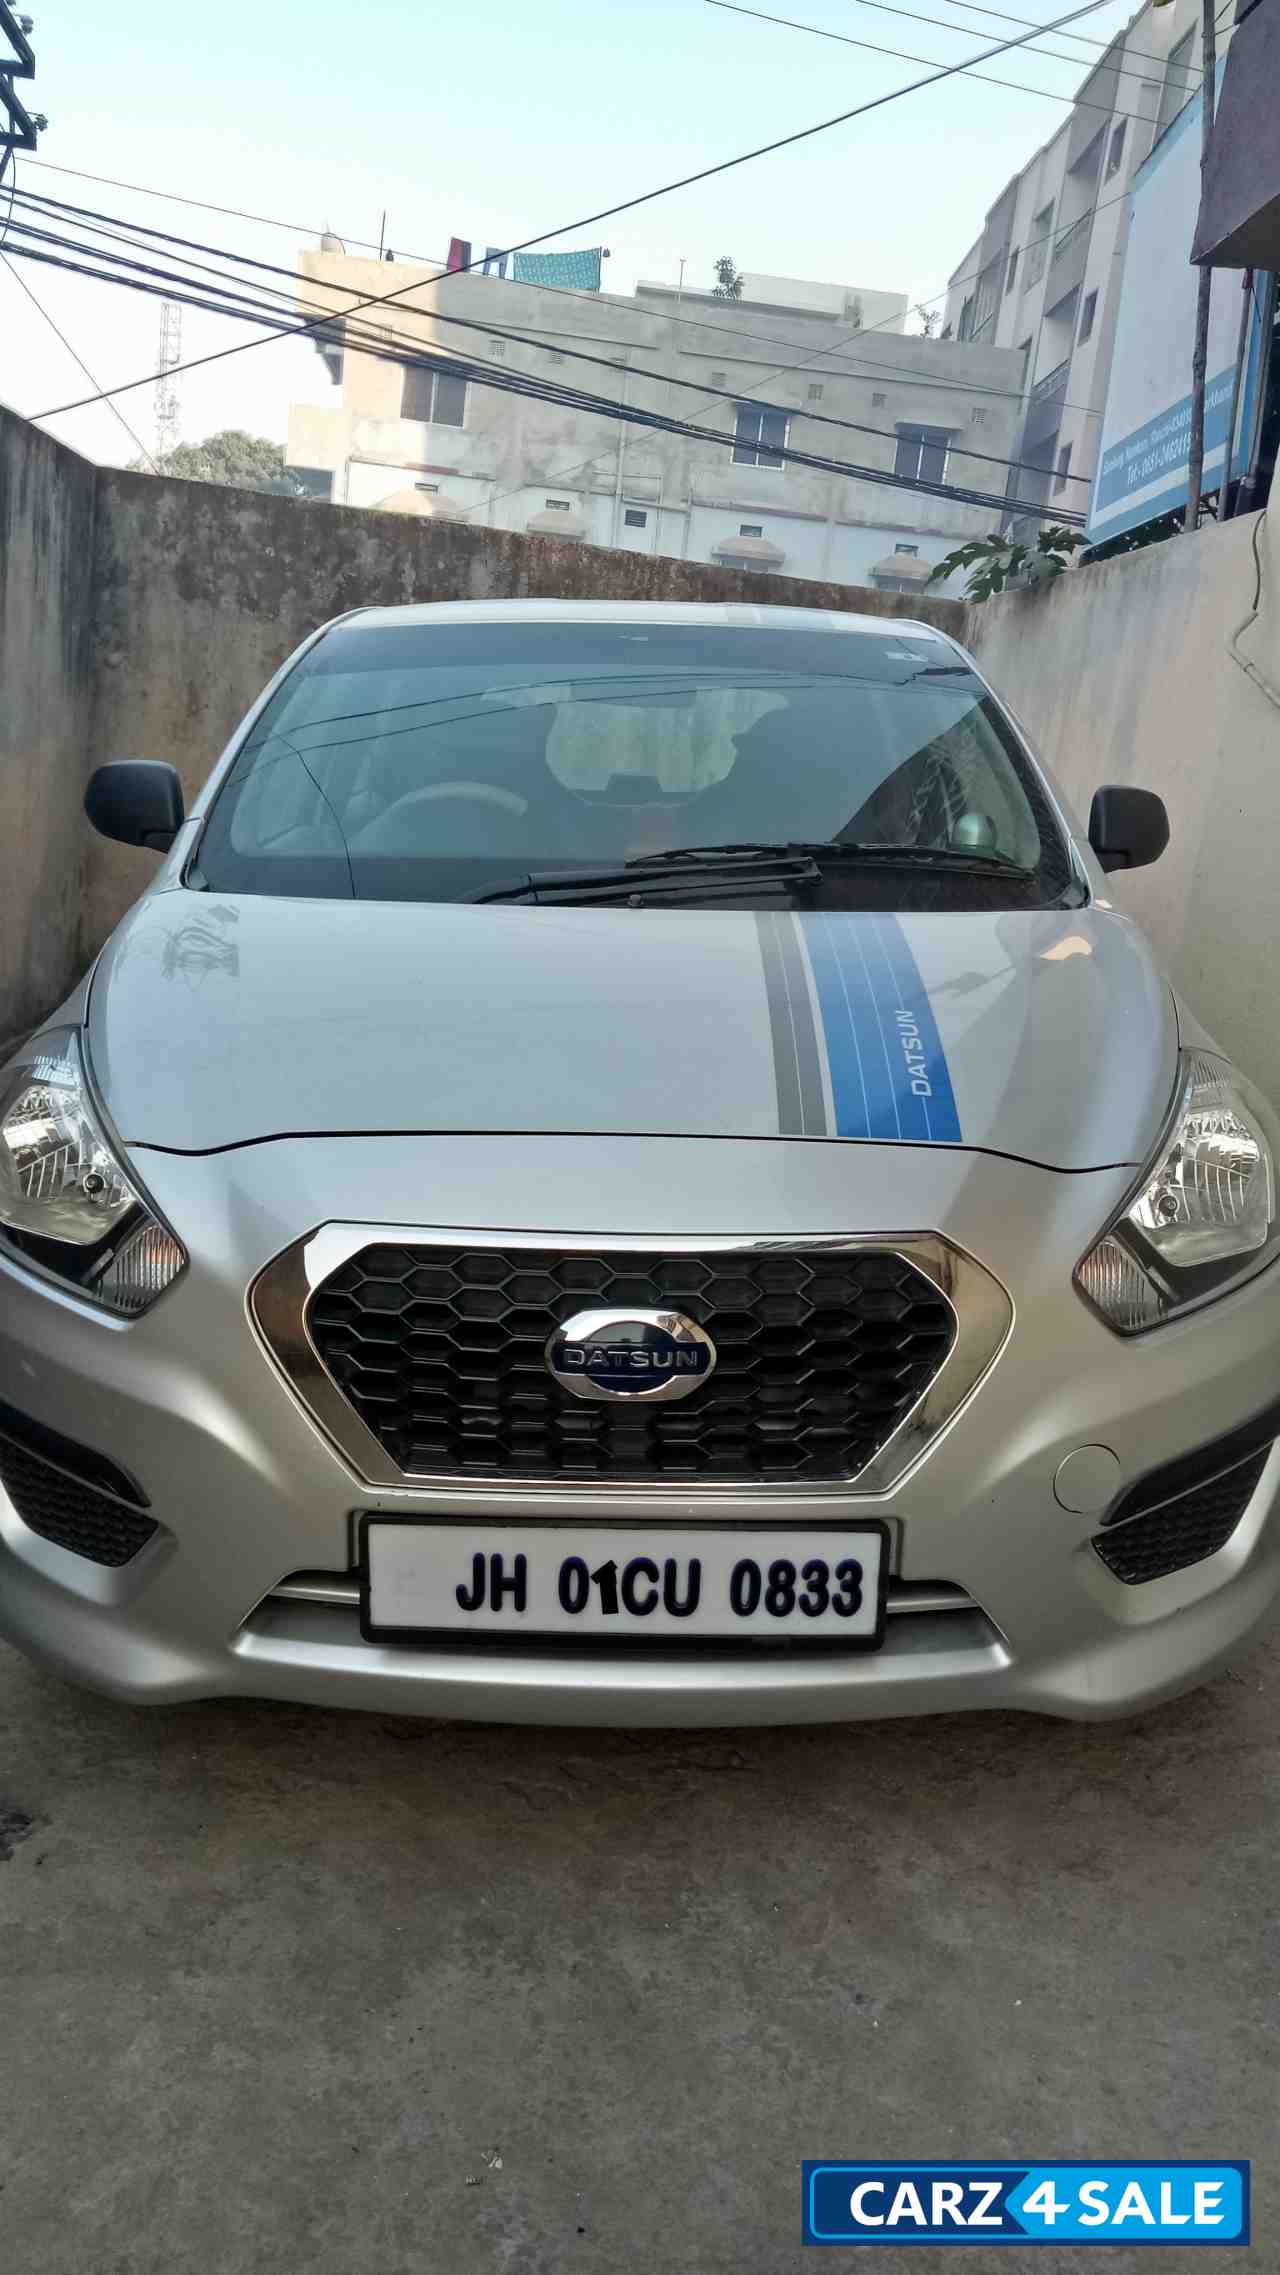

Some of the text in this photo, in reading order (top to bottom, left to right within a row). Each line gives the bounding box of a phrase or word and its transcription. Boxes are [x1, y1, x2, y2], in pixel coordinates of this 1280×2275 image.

[895, 1009, 932, 1097] DATSUN
[563, 1348, 698, 1369] DATSUN
[455, 1551, 864, 1618] JH 01CU 0833
